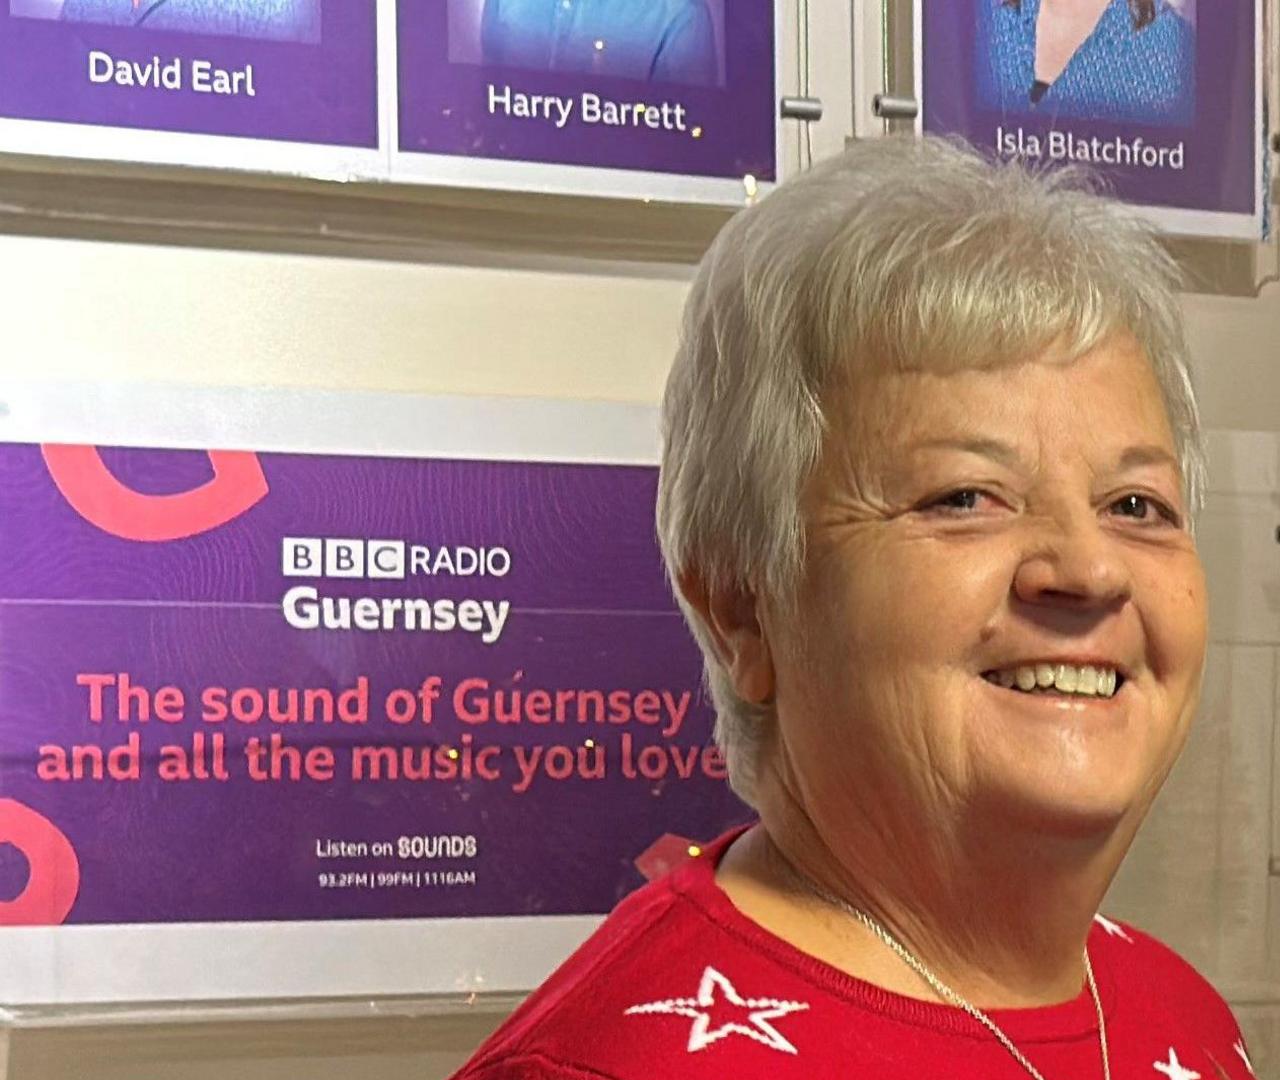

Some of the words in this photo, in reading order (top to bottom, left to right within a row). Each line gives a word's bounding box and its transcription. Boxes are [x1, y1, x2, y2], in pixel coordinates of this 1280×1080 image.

[88, 51, 182, 90] David
[191, 60, 256, 97] Earl
[487, 84, 573, 128] Harry
[581, 93, 687, 132] Barrett
[996, 126, 1041, 157] Isla
[1049, 131, 1184, 170] Blatchford
[287, 541, 402, 576] BBC
[411, 546, 511, 576] RADIO
[282, 586, 510, 643] Guernsey
[76, 672, 185, 722] The
[201, 676, 369, 723] sound
[385, 676, 442, 724] of
[453, 677, 691, 737] Guernsey
[36, 731, 140, 781] and
[158, 731, 229, 781] all
[245, 732, 335, 781] the
[352, 733, 501, 781] music
[512, 743, 606, 793] you
[621, 733, 730, 780] love
[316, 839, 369, 858] Listen
[371, 841, 394, 857] on
[377, 871, 414, 887] 99FM
[424, 870, 477, 887] 1116AM
